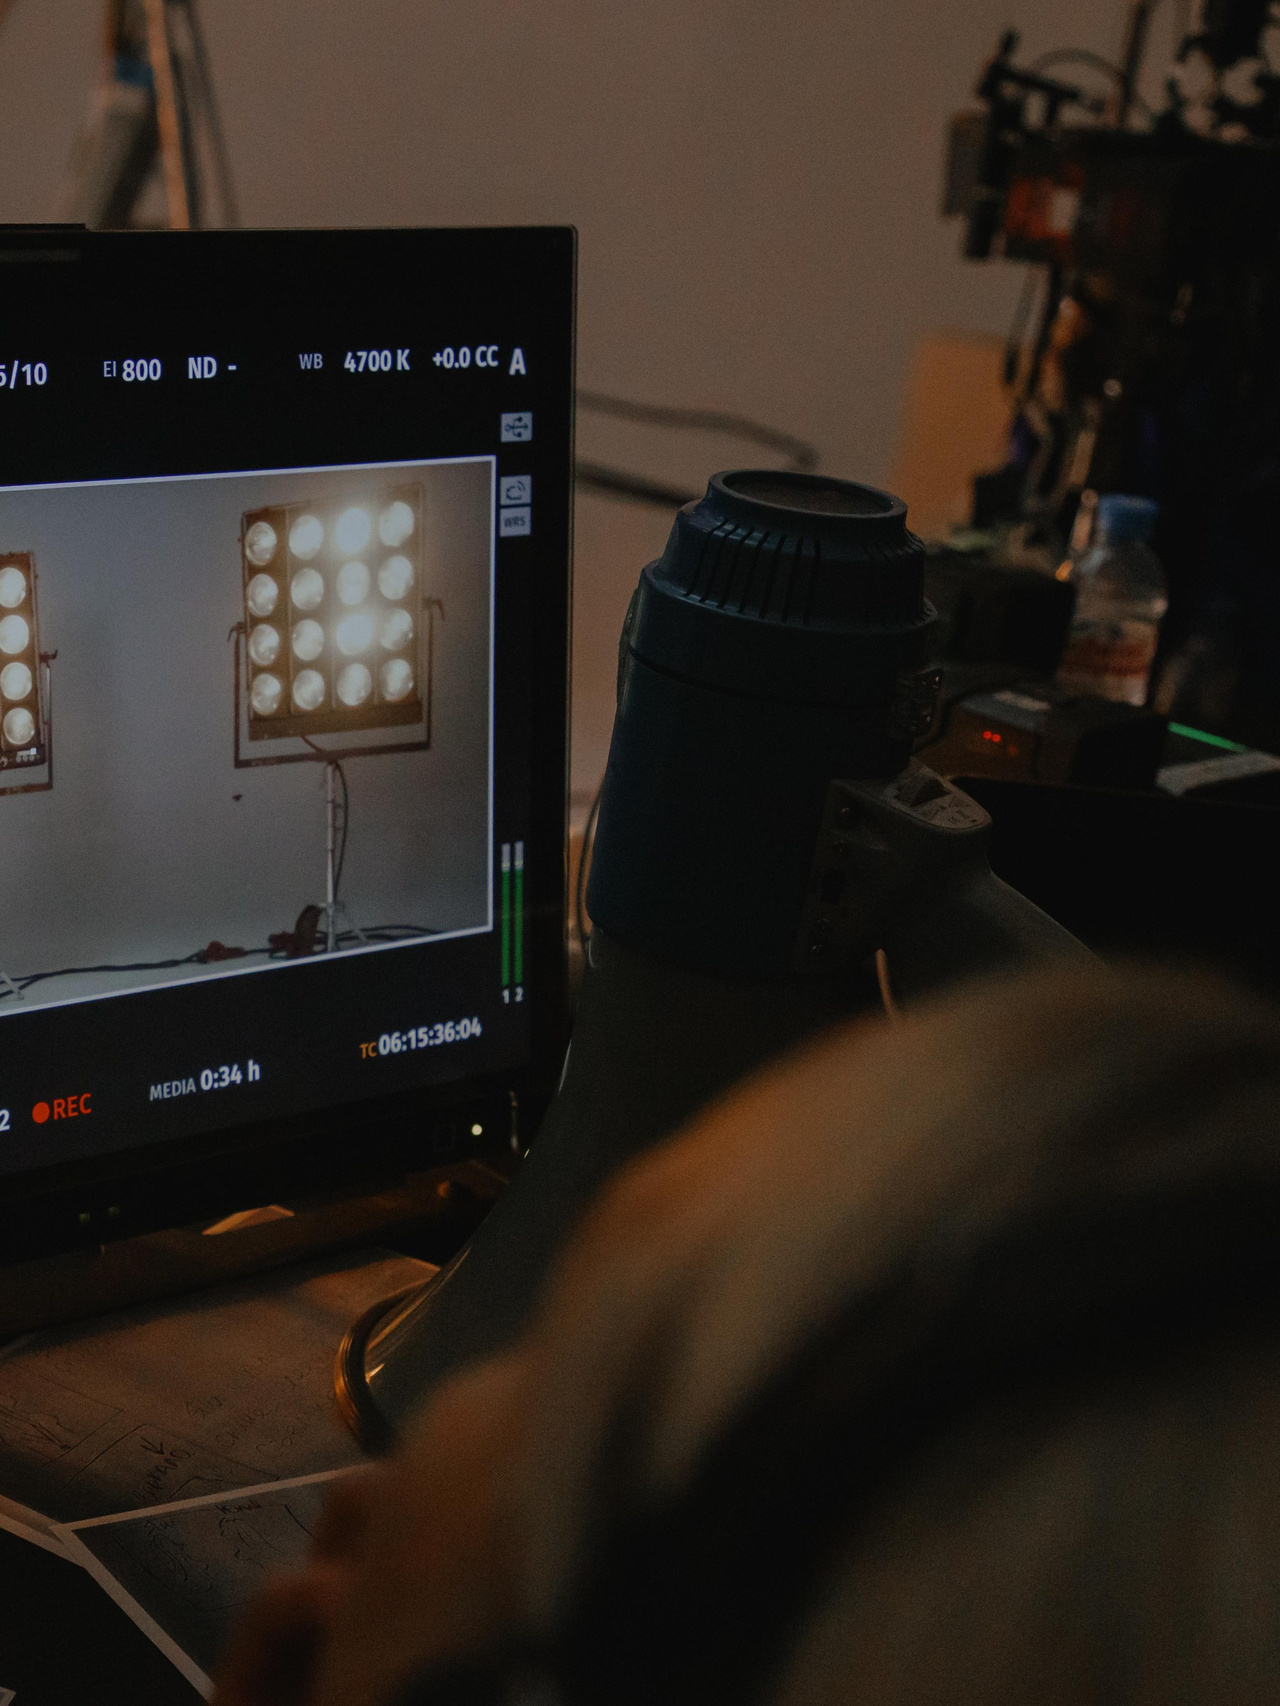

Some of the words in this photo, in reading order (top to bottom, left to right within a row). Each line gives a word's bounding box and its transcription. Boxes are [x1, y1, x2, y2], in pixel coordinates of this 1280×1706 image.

[188, 356, 217, 379] ND
[299, 353, 323, 369] WB
[344, 349, 393, 372] 4700
[397, 348, 410, 370] K
[432, 346, 471, 368] +0.0
[475, 344, 499, 367] CC
[509, 347, 526, 375] A
[104, 361, 116, 377] EI
[122, 358, 162, 381] 800
[503, 515, 528, 530] WRS
[502, 988, 510, 1004] 1
[515, 986, 524, 1002] 2
[360, 1042, 377, 1059] TC
[378, 1017, 482, 1056] 06:15:36:04
[150, 1078, 196, 1101] MEDIA
[200, 1064, 243, 1090] 0:34
[247, 1059, 261, 1082] h
[53, 1093, 91, 1120] REC
